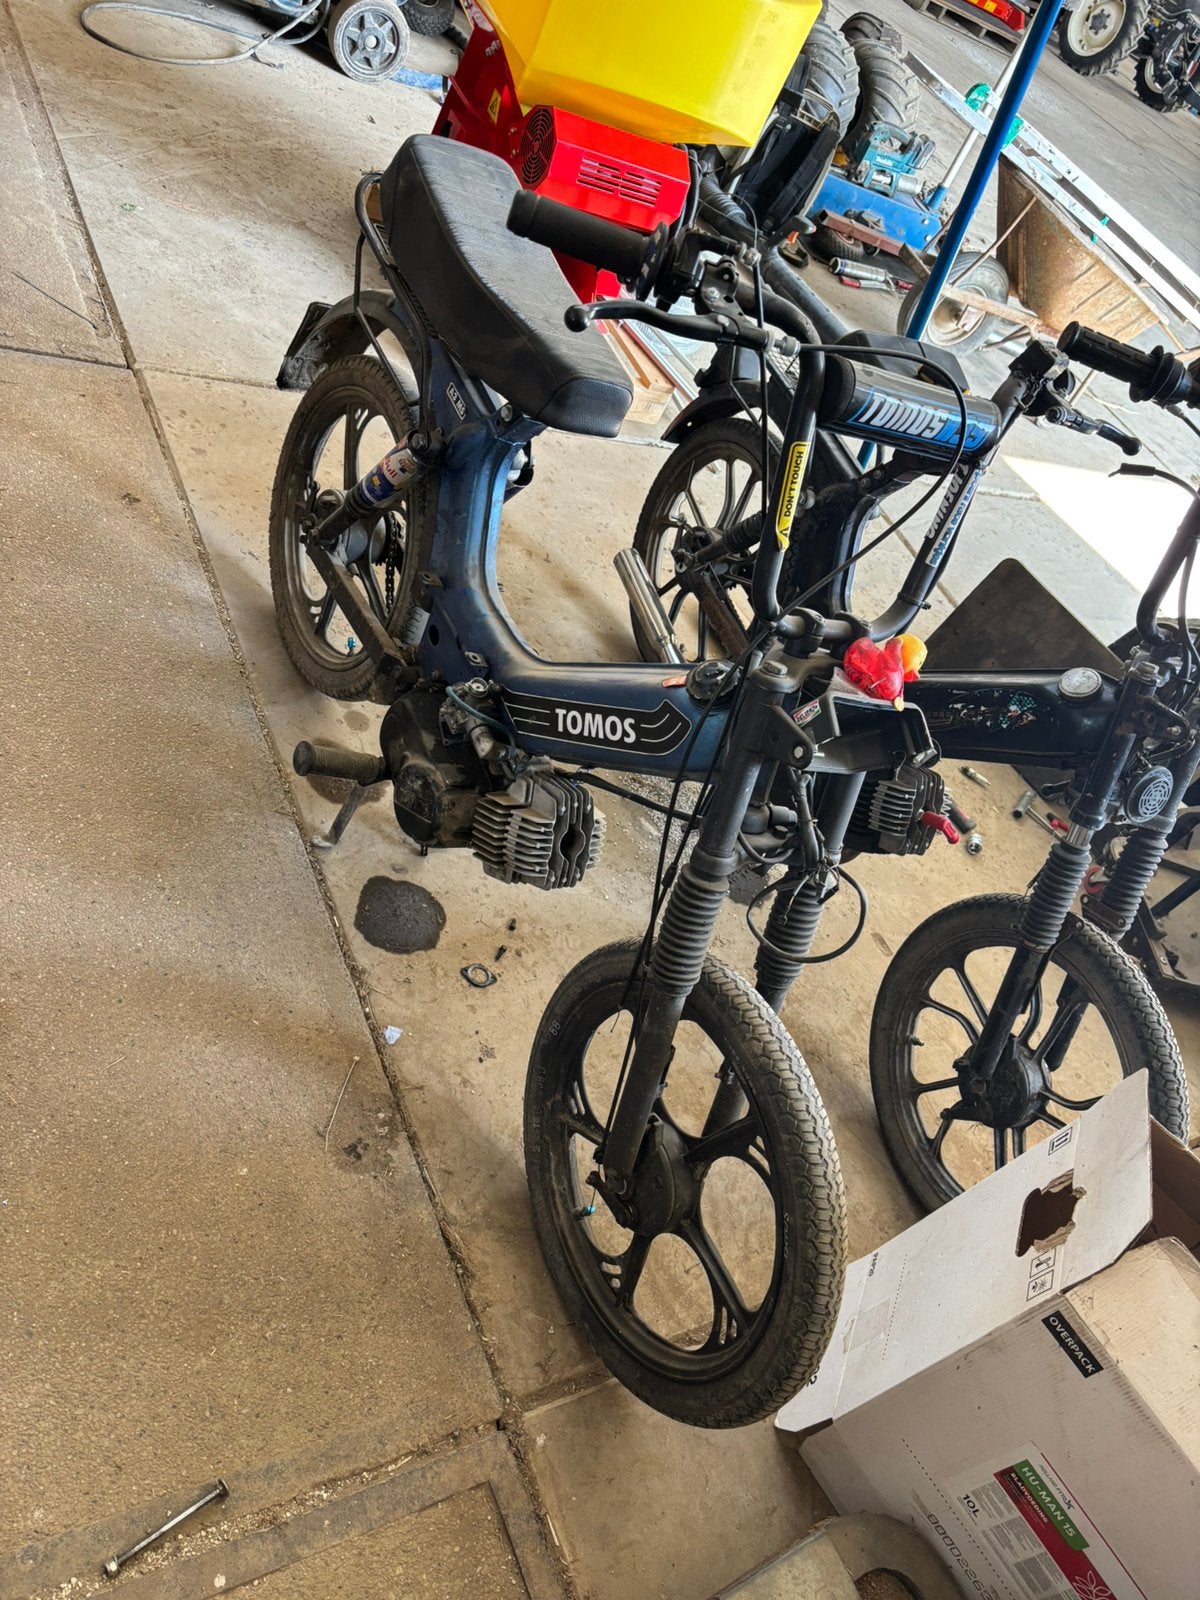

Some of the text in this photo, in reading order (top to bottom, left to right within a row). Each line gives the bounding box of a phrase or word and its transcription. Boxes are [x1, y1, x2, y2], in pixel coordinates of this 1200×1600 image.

[858, 393, 949, 439] TOMOS
[784, 451, 804, 517] DON'T TOUCH
[555, 708, 636, 743] TOMOS
[1049, 1316, 1096, 1374] OVERPACK
[963, 1493, 980, 1518] 10L
[1010, 1472, 1049, 1523] BLADVOEDING
[1022, 1467, 1064, 1521] HU-MAN
[1062, 1522, 1077, 1537] 15
